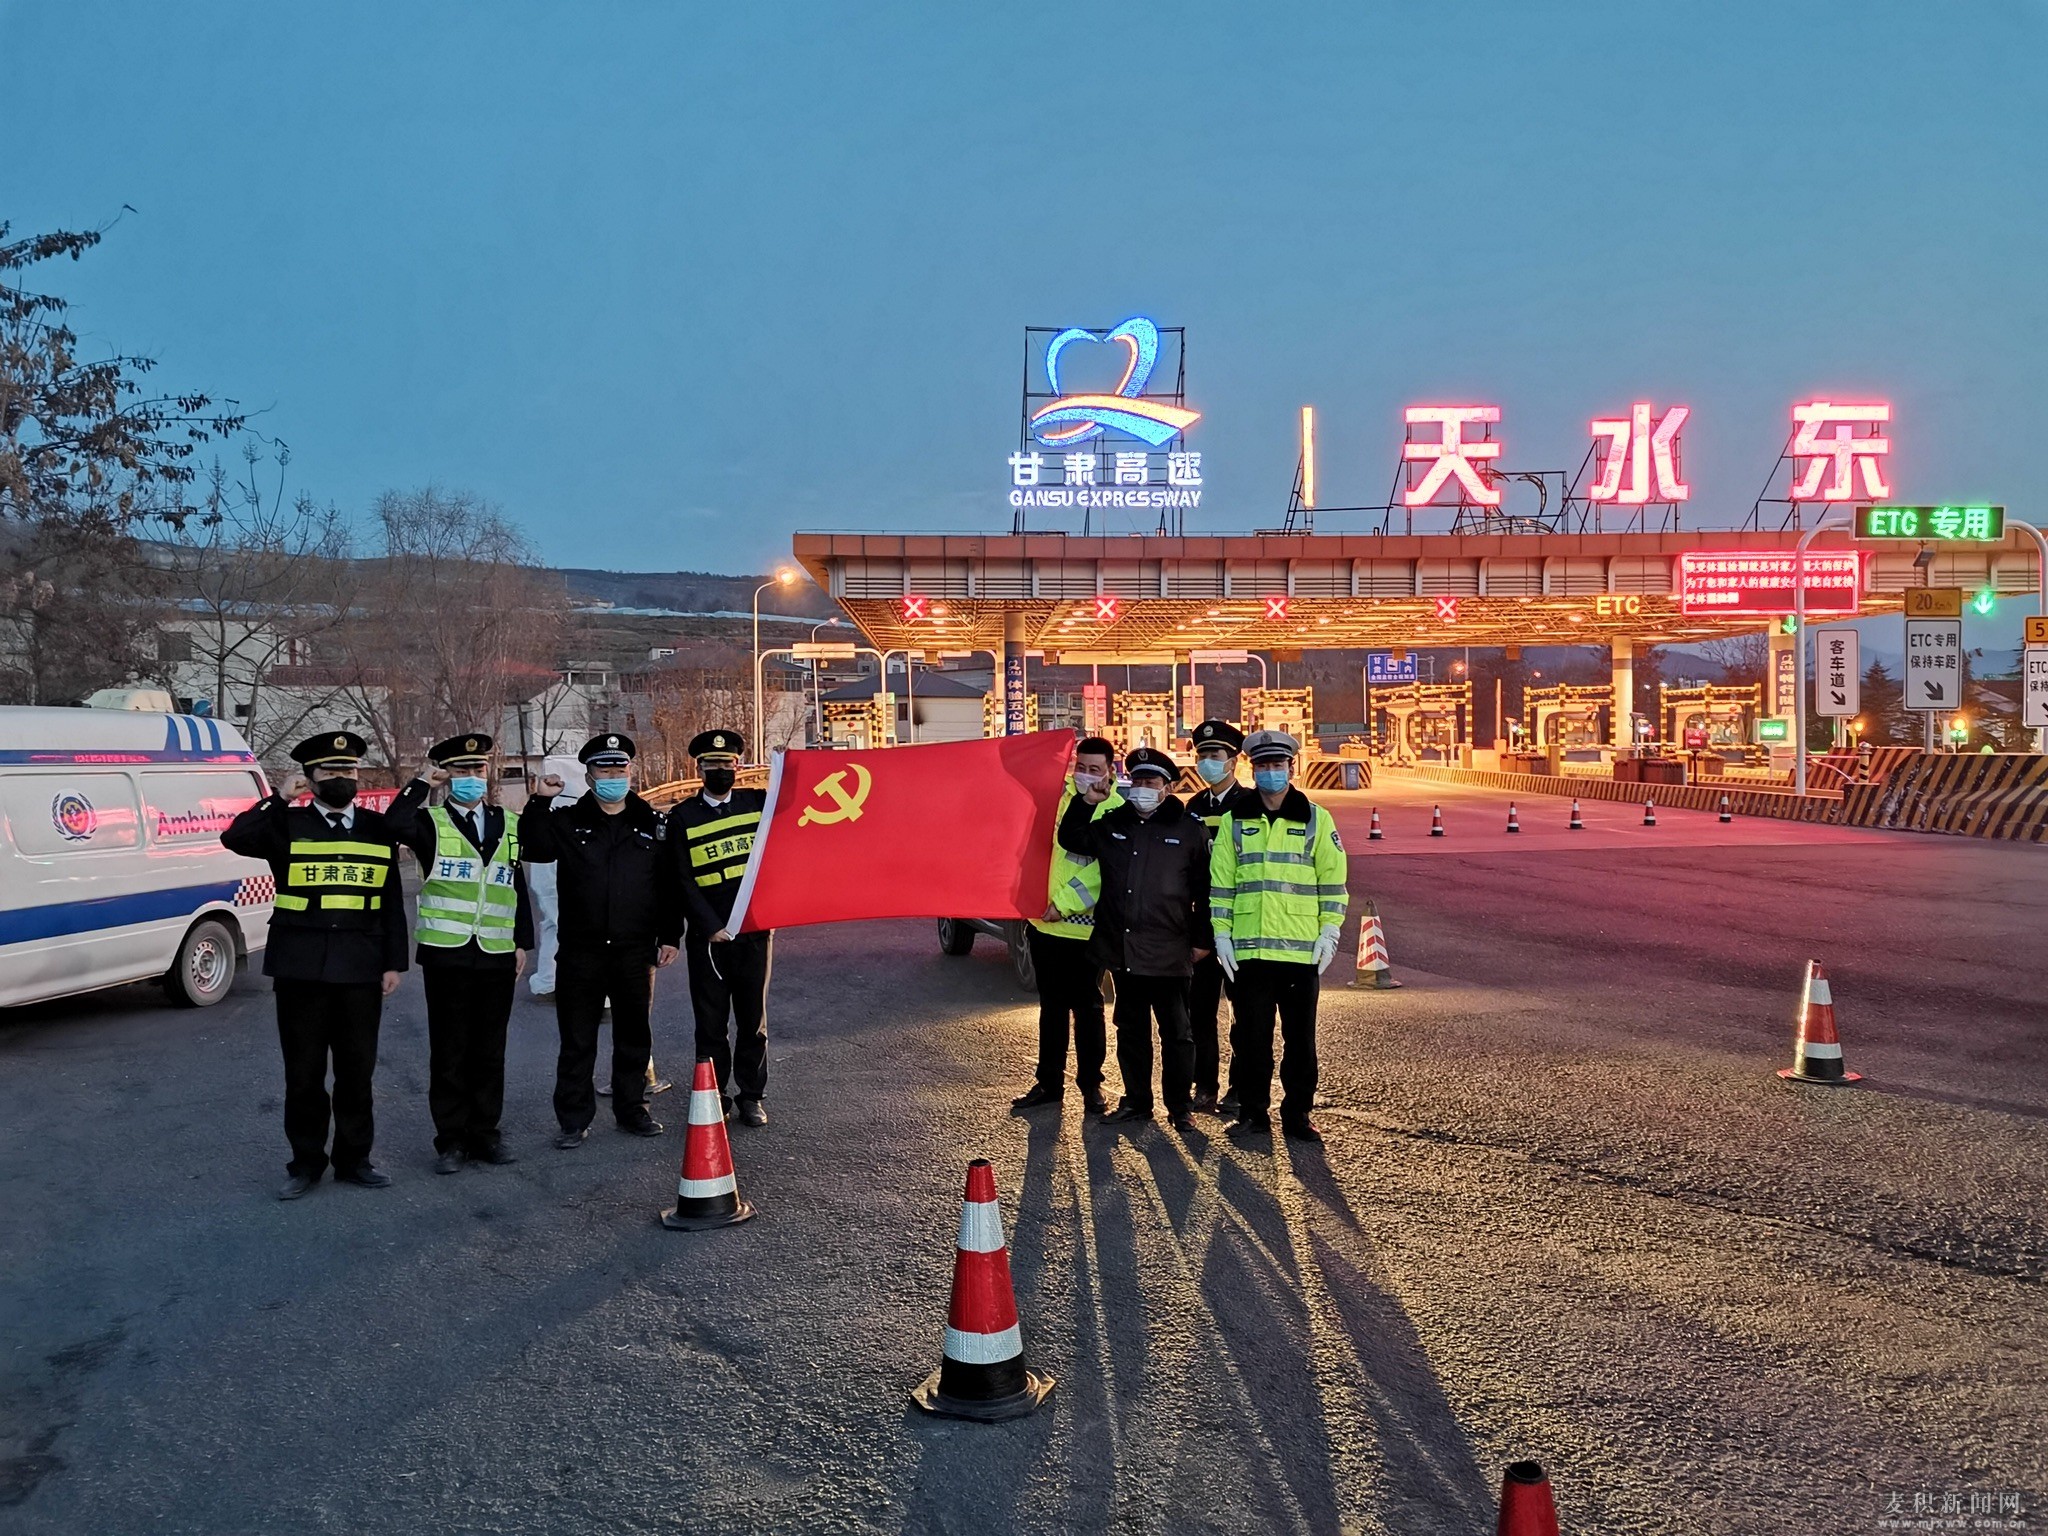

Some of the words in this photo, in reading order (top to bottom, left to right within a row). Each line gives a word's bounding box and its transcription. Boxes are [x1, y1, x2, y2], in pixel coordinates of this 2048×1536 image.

[1403, 401, 1890, 506] 天水东
[1008, 451, 1202, 486] 甘肃高速
[1009, 489, 1073, 507] GANSU
[1076, 489, 1201, 508] EXPRESSWAY
[1870, 510, 1917, 536] ETC
[1929, 506, 1990, 539] 专用
[1597, 596, 1640, 615] ETC
[1916, 594, 1932, 610] 20
[1910, 633, 1932, 647] ETC
[1934, 633, 1957, 647] 专用
[1830, 640, 1845, 687] 客车道
[1910, 655, 1957, 669] 保持车距
[1007, 680, 1023, 735] 体验五心服
[704, 836, 756, 859] 甘肃高
[302, 865, 375, 884] 甘肃高速
[439, 859, 473, 879] 甘肃
